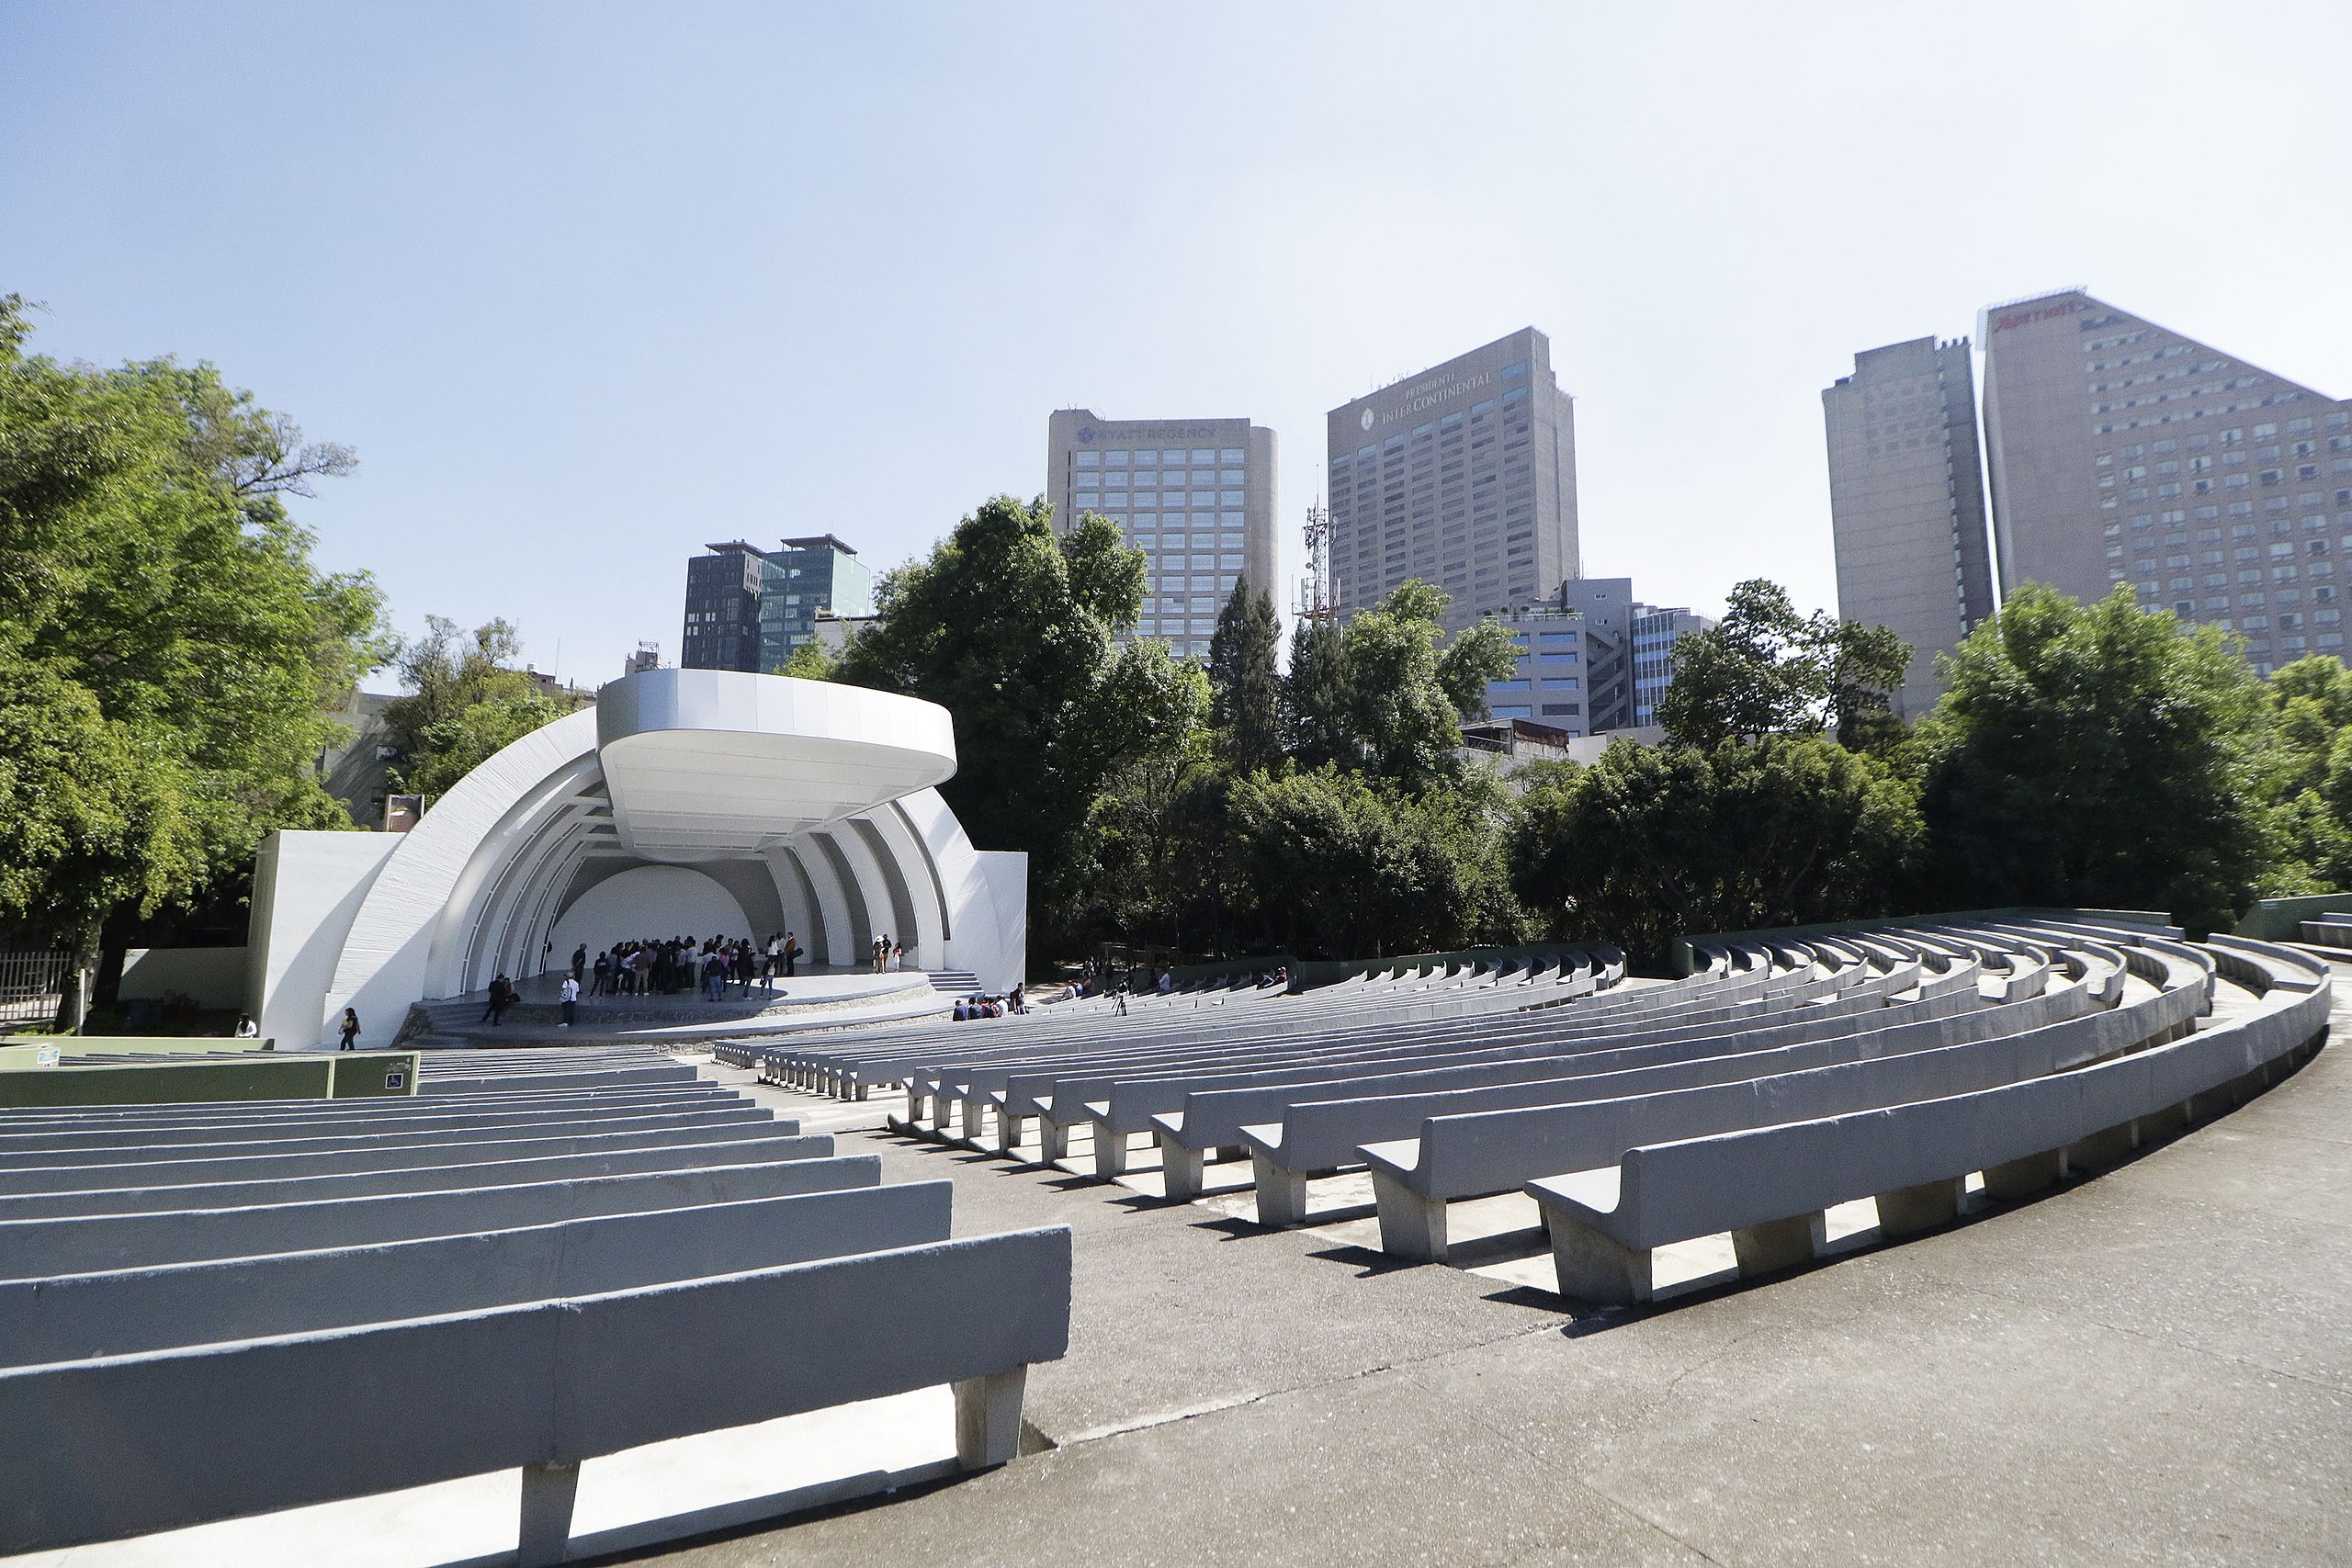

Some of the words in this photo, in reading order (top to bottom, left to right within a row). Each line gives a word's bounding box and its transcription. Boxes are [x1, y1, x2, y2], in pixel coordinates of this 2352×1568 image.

[1405, 372, 1457, 400] PRESIDENTE
[1098, 429, 1143, 441] HYATT
[1148, 428, 1216, 439] REGENCY
